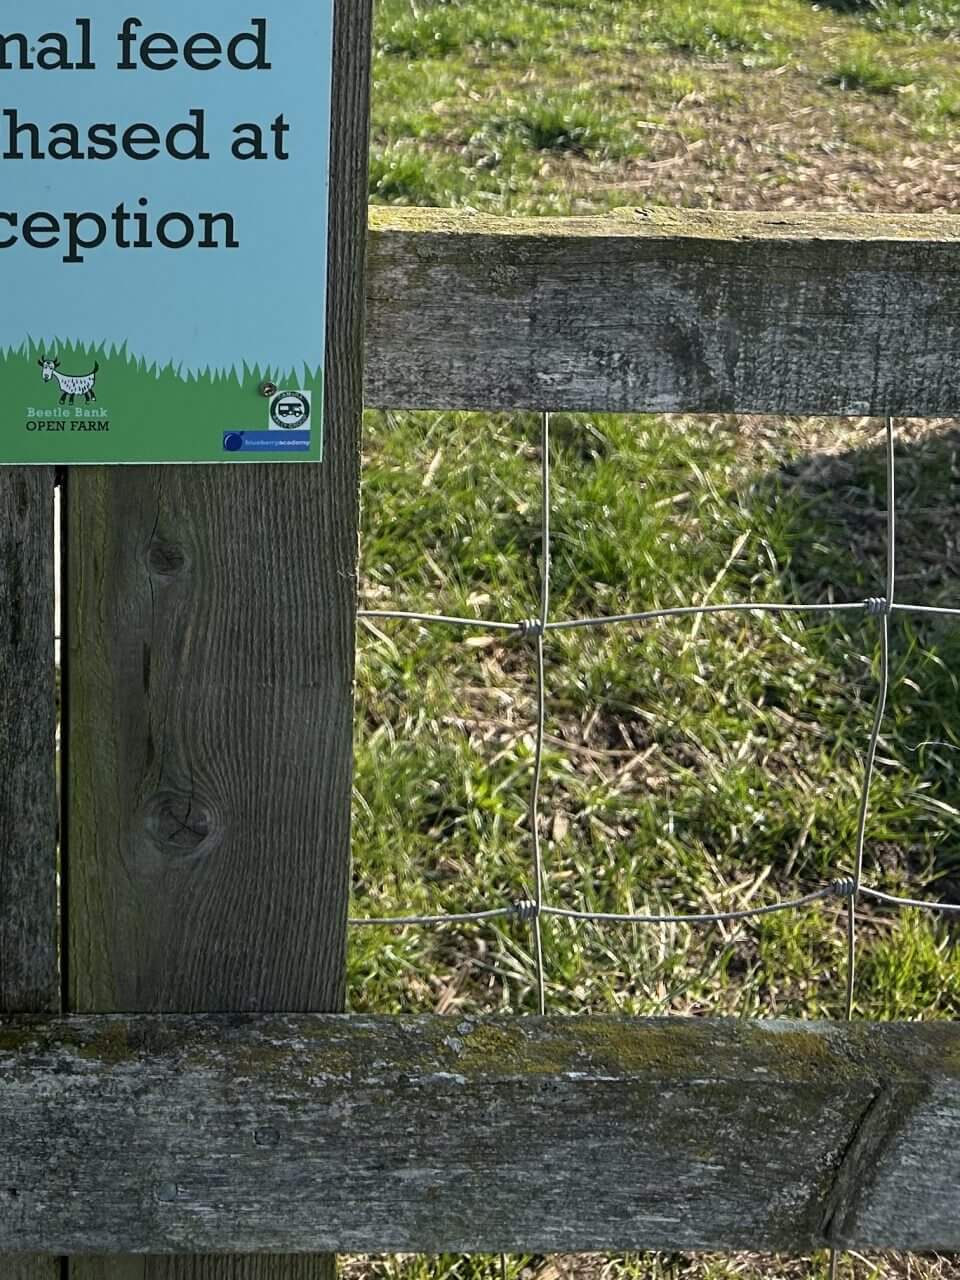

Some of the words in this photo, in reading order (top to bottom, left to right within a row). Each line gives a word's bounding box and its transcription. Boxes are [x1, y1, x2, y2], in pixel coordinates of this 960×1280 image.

[116, 17, 272, 71] feed
[231, 113, 290, 161] at
[26, 421, 65, 431] OPEN
[70, 421, 109, 432] FARM
[27, 407, 70, 418] Beetle
[75, 407, 108, 418] Bank
